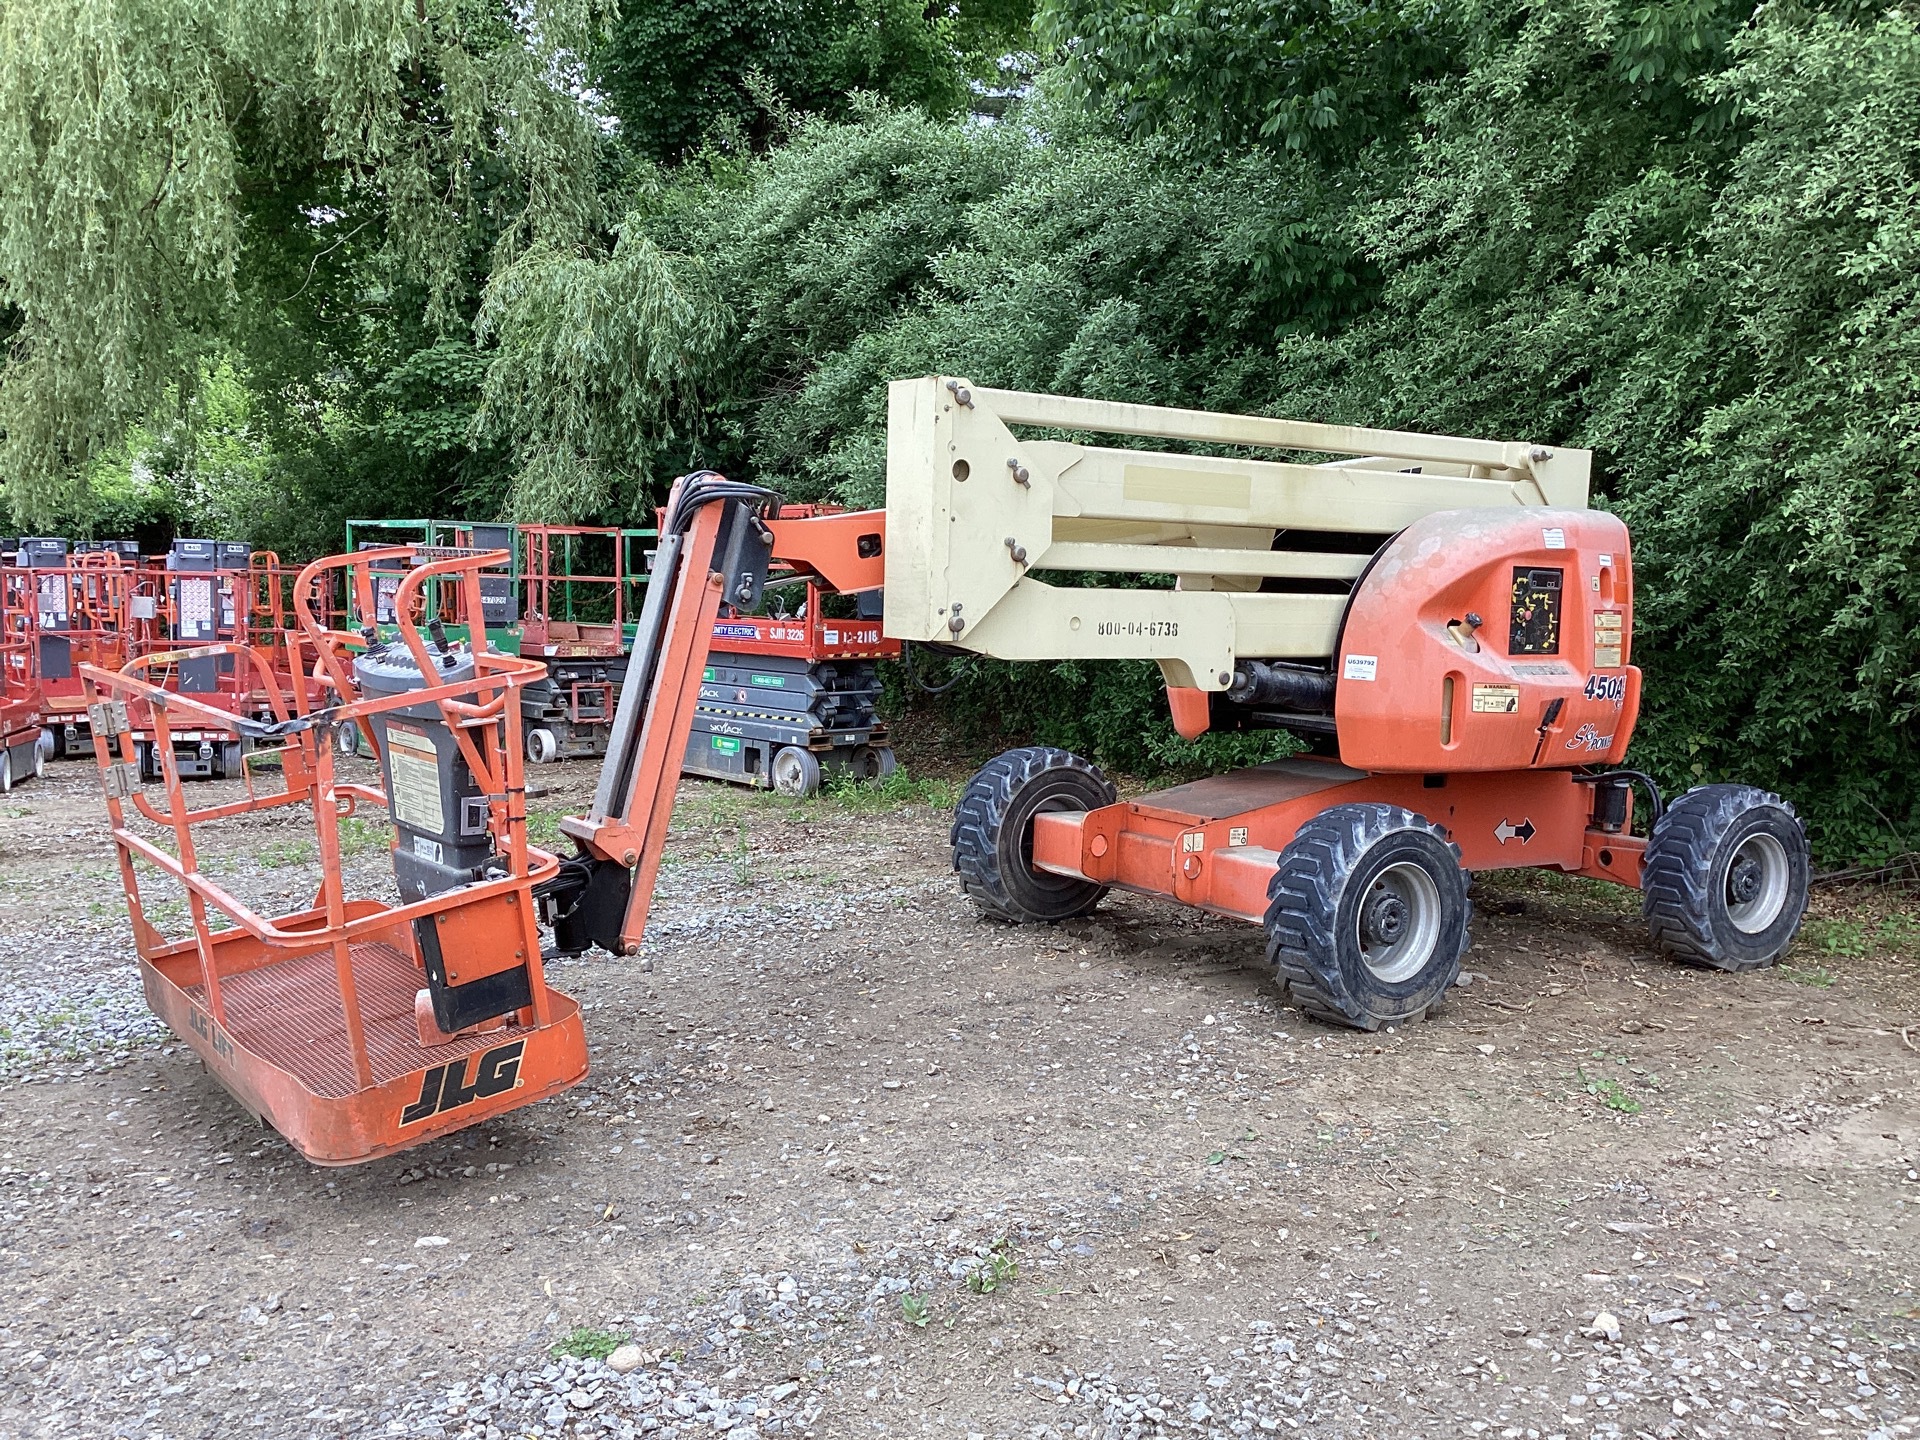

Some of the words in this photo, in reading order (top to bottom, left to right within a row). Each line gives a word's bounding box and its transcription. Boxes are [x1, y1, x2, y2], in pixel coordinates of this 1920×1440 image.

[727, 627, 754, 636] ELECTRIC
[786, 628, 805, 641] 3226
[1098, 622, 1179, 637] 800-04-6738
[1583, 675, 1626, 700] 450A
[709, 722, 743, 735] SKYJACK
[210, 1023, 236, 1069] LIFT
[399, 1038, 528, 1128] JLG
